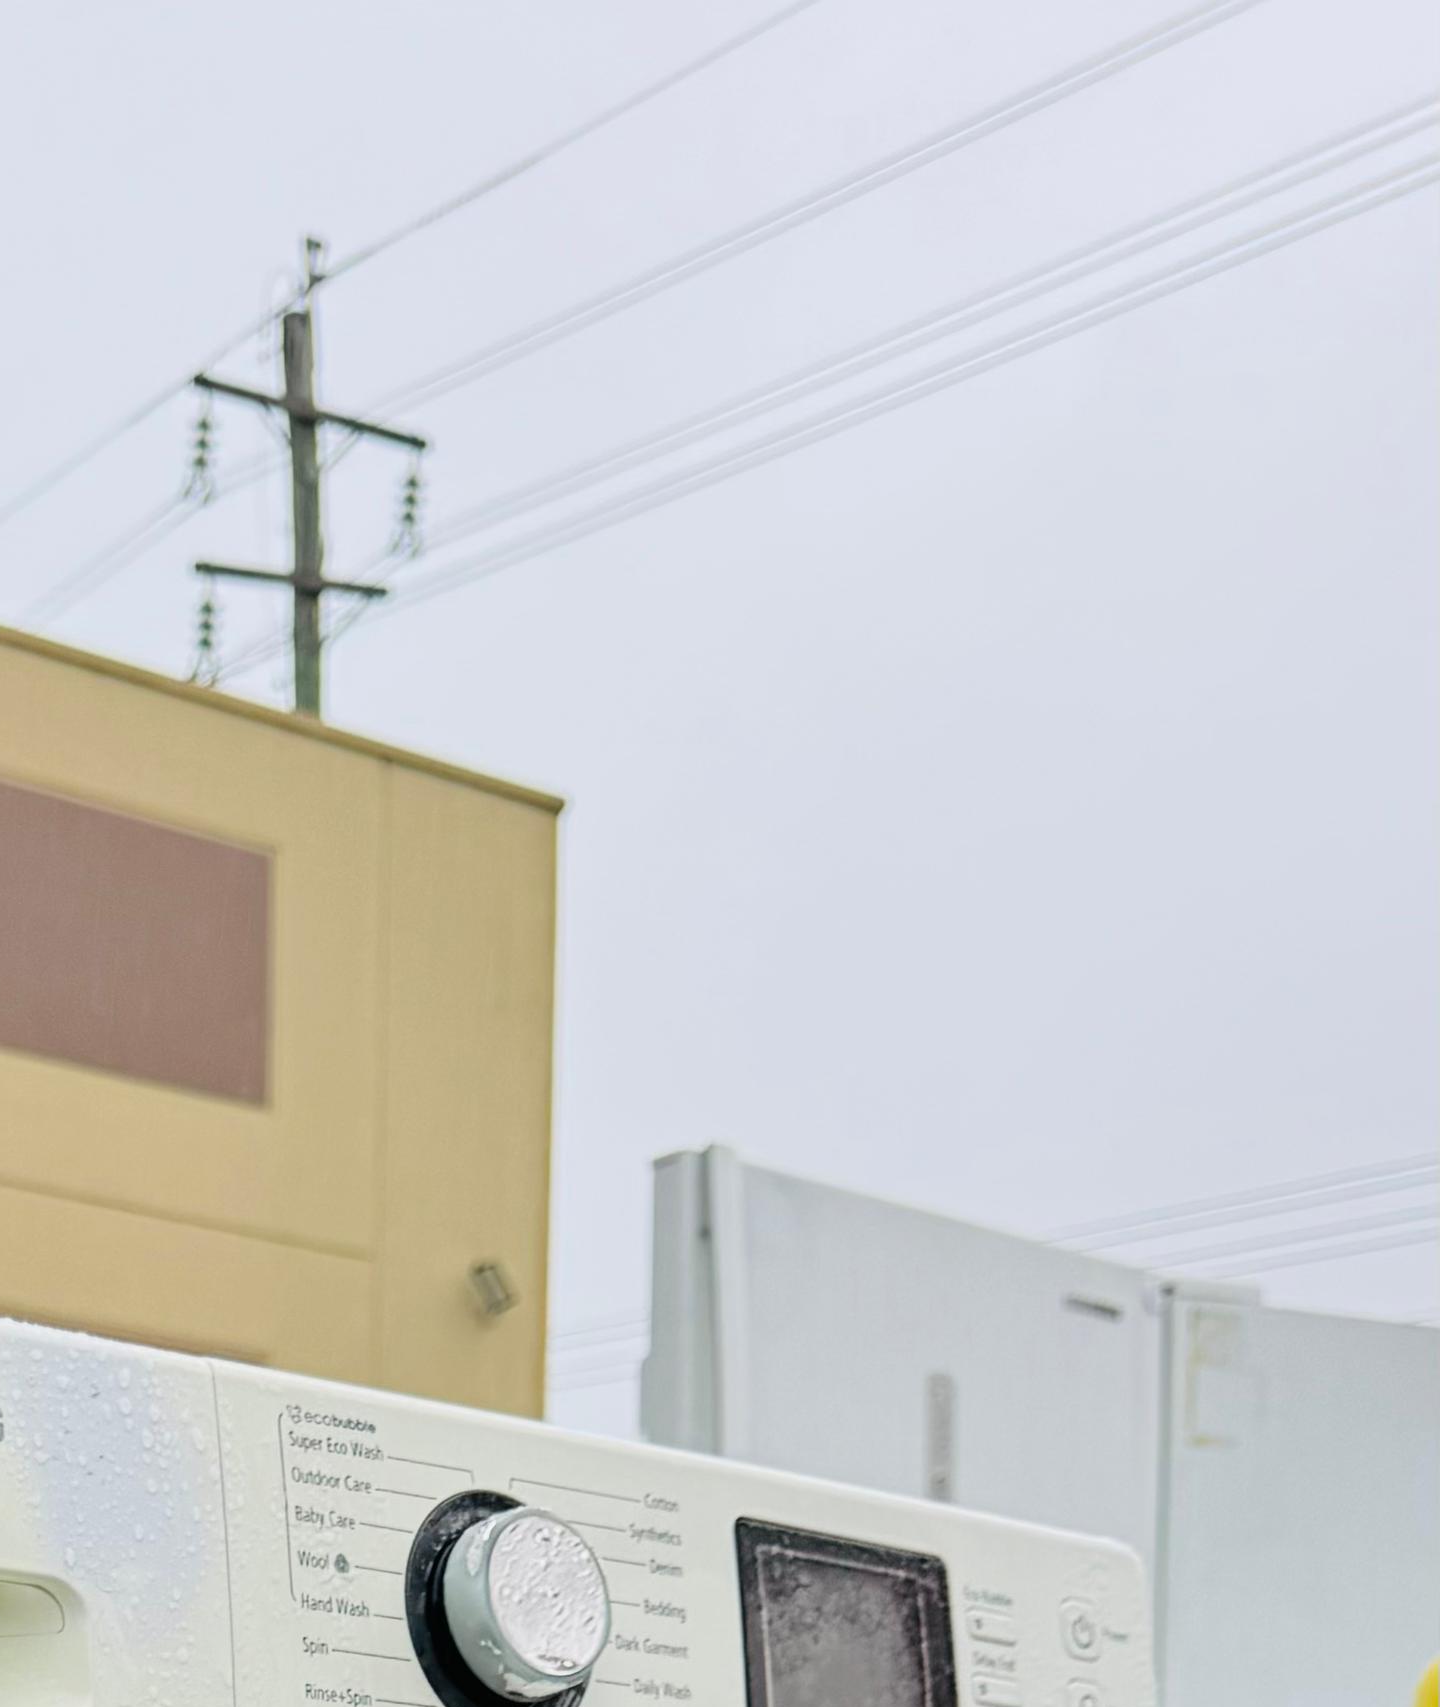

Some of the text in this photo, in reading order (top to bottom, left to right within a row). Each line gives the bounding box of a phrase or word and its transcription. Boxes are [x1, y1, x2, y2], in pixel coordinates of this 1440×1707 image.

[289, 1430, 384, 1461] Super Eco Wash
[291, 1466, 372, 1494] Outdoor Care
[644, 1493, 679, 1512] Cotton
[295, 1505, 355, 1530] Baby Care
[629, 1523, 681, 1546] Synthetics
[297, 1550, 329, 1569] Wool
[650, 1559, 683, 1577] Denim
[301, 1592, 370, 1617] Hand Wash
[644, 1598, 686, 1623] Bedding
[302, 1636, 329, 1656] Spin
[615, 1634, 688, 1658] Dark Garment
[305, 1683, 372, 1707] Rinse+Spin
[634, 1678, 692, 1700] Daily Wash
